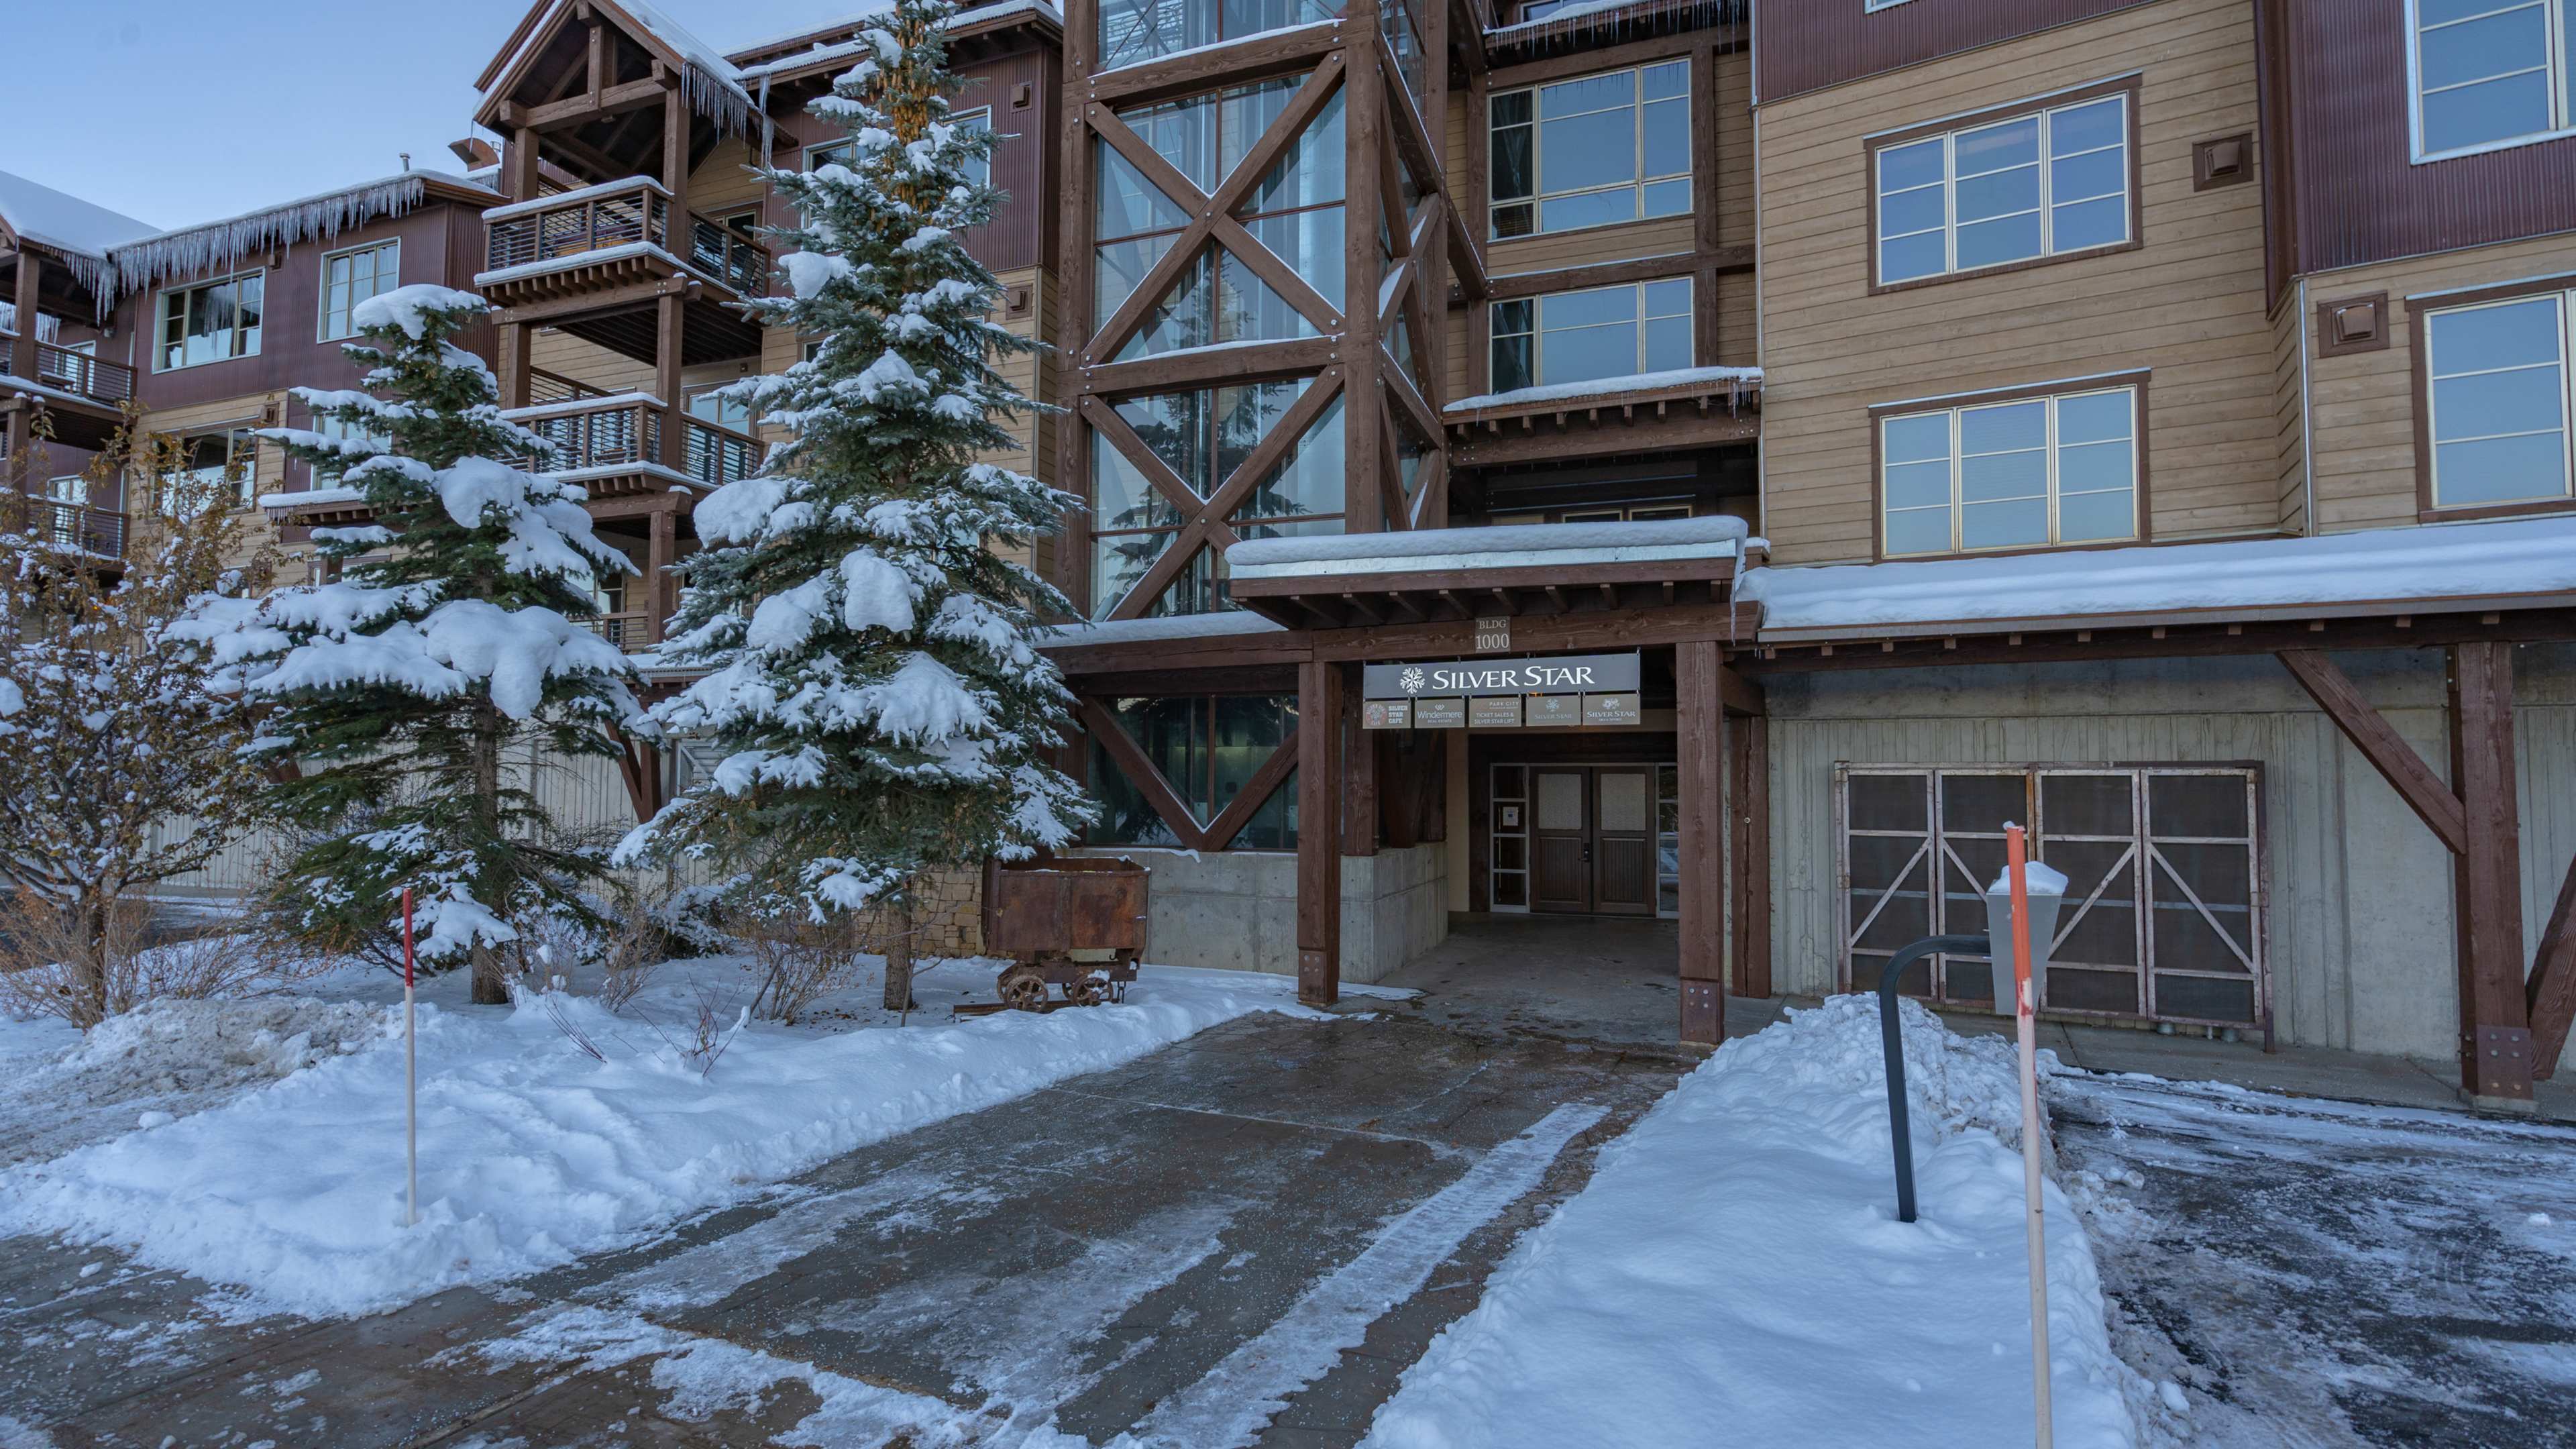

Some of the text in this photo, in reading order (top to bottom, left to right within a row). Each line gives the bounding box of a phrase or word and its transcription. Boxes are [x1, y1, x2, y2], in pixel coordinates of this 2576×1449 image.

[1479, 619, 1506, 629] BLDG
[1475, 633, 1509, 649] 1000
[1432, 665, 1596, 690] SILVER STAR
[1417, 710, 1463, 719] Windermere
